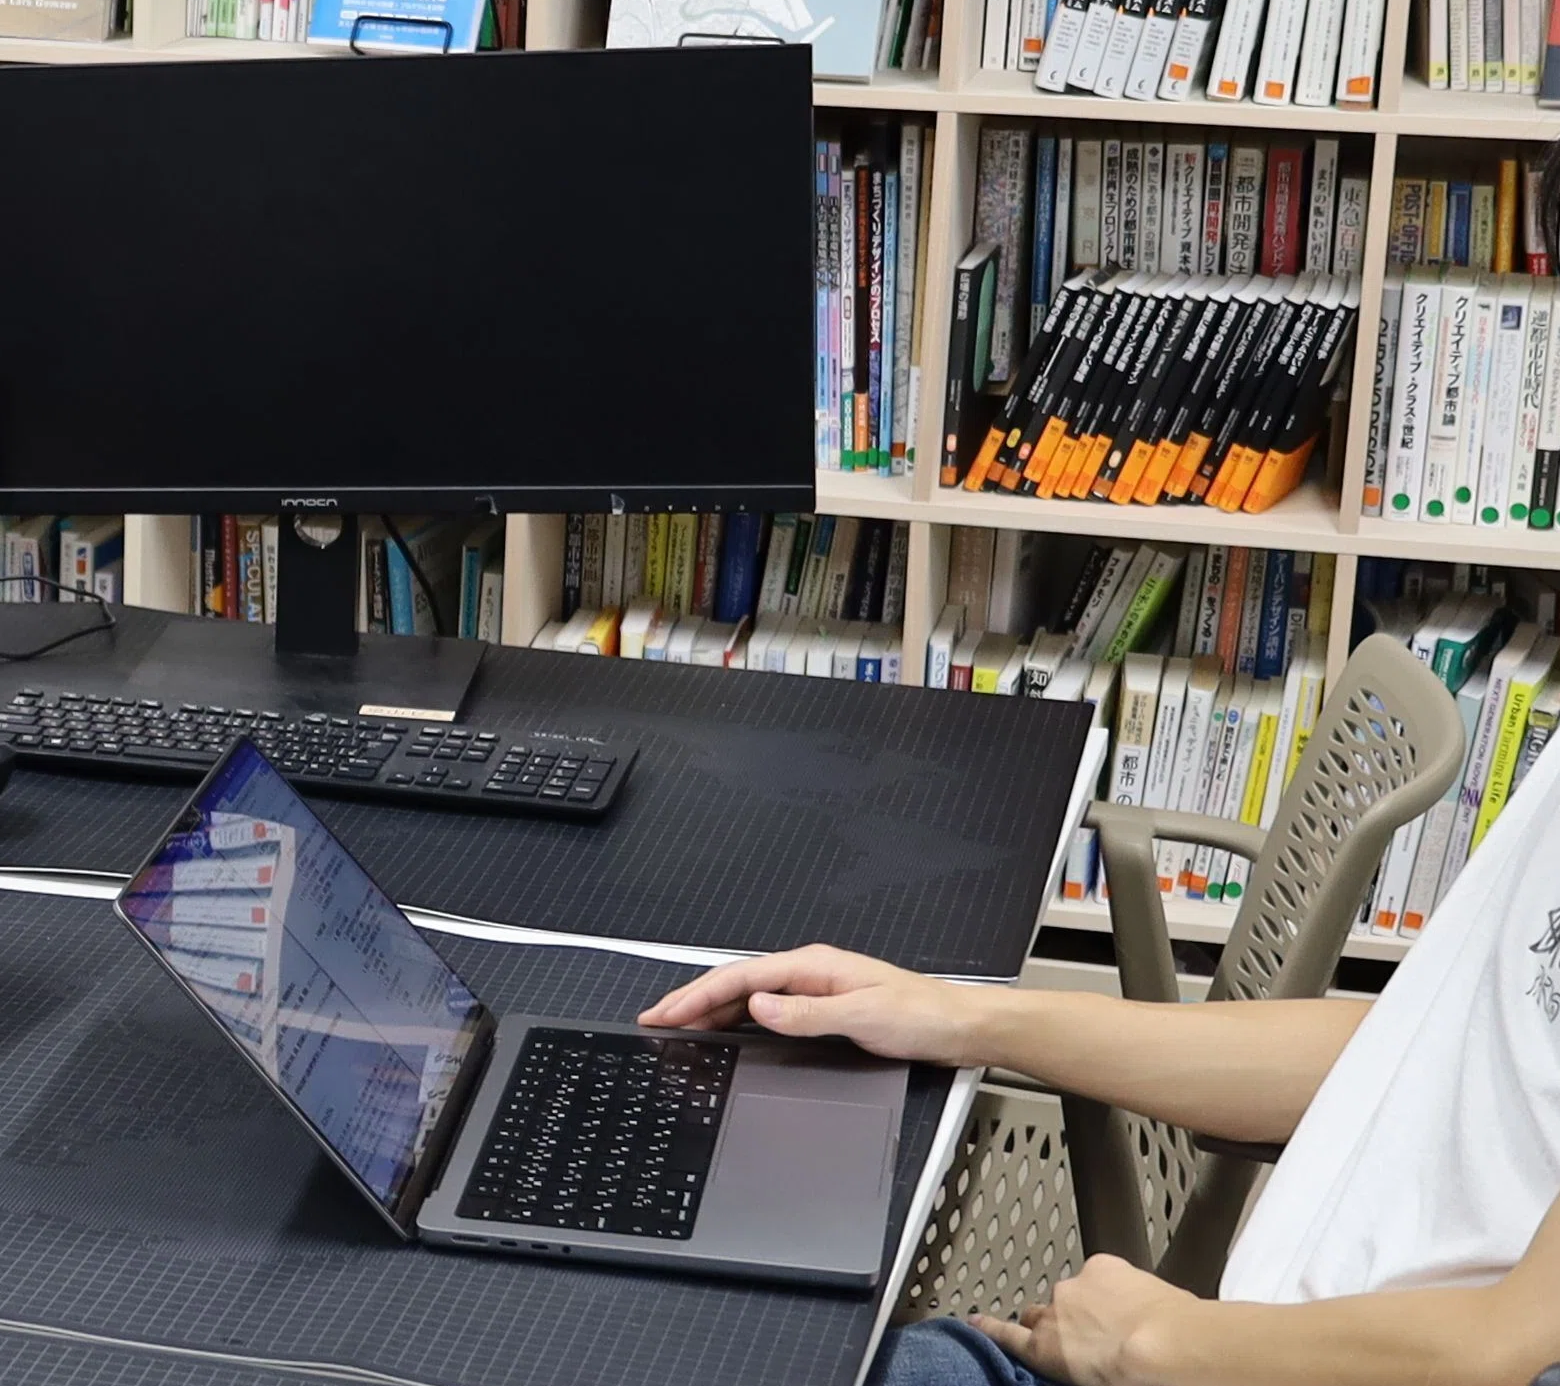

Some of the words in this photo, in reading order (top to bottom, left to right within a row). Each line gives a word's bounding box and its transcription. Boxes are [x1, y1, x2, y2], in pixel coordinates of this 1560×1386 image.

[1400, 292, 1428, 449] クリエイティブ・クラスの世紀
[1442, 295, 1468, 427] クリエイティブ都市論
[1504, 692, 1525, 728] Urban
[1489, 779, 1506, 804] Life
